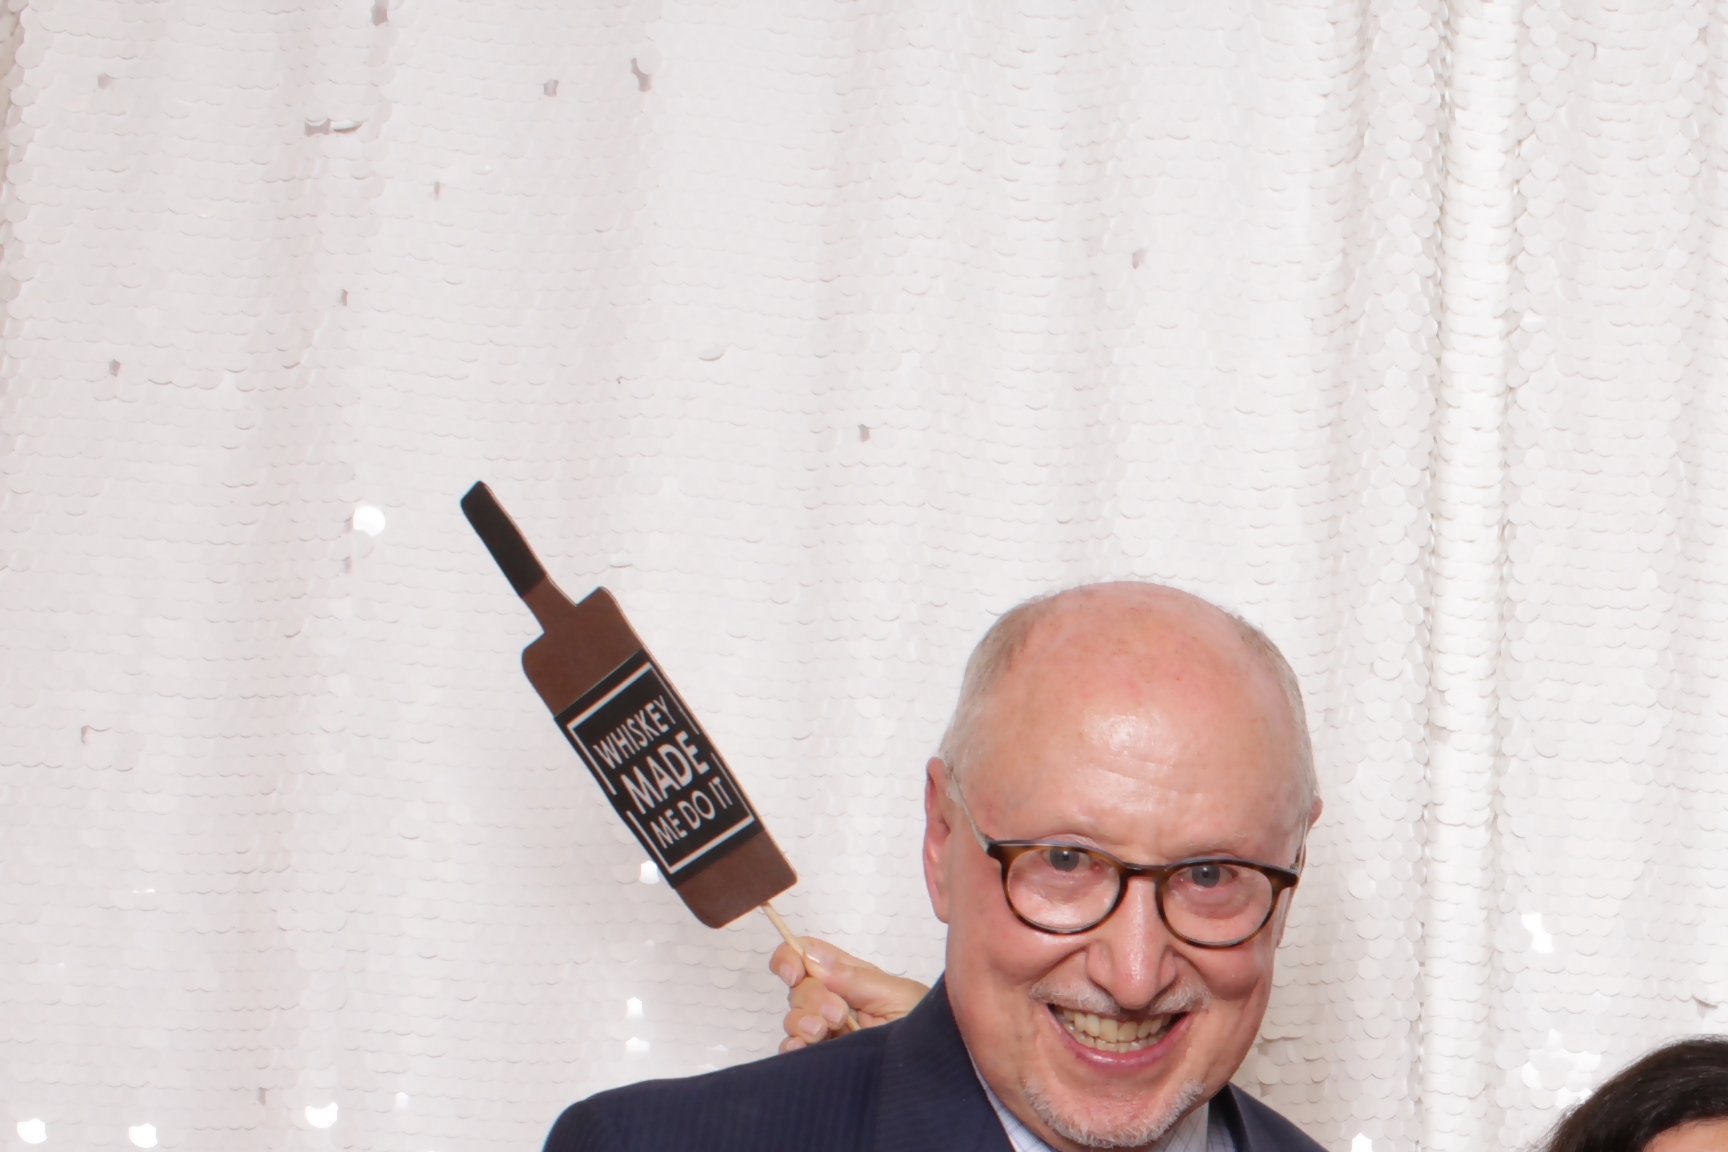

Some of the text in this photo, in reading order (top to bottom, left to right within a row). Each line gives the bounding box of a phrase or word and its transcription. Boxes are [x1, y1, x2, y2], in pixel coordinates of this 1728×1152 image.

[592, 695, 676, 769] WHISKEY
[620, 731, 709, 815] MADE
[650, 776, 733, 849] ME DO IT
